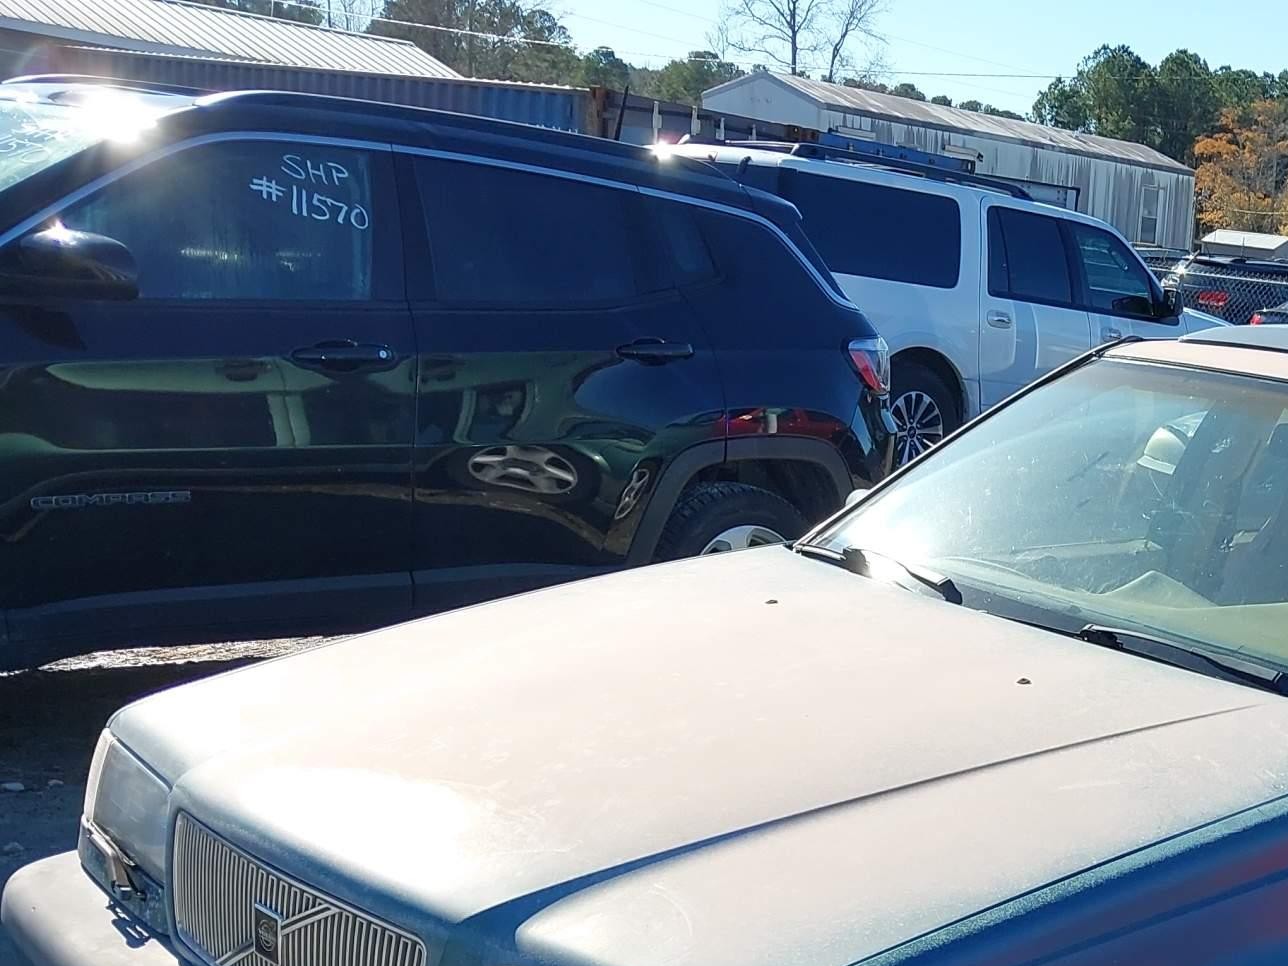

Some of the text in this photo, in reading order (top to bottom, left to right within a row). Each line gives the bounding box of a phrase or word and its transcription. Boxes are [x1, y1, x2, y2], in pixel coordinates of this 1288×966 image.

[281, 154, 349, 185] SHP
[249, 176, 369, 229] #11570
[31, 490, 192, 508] COMPASS
